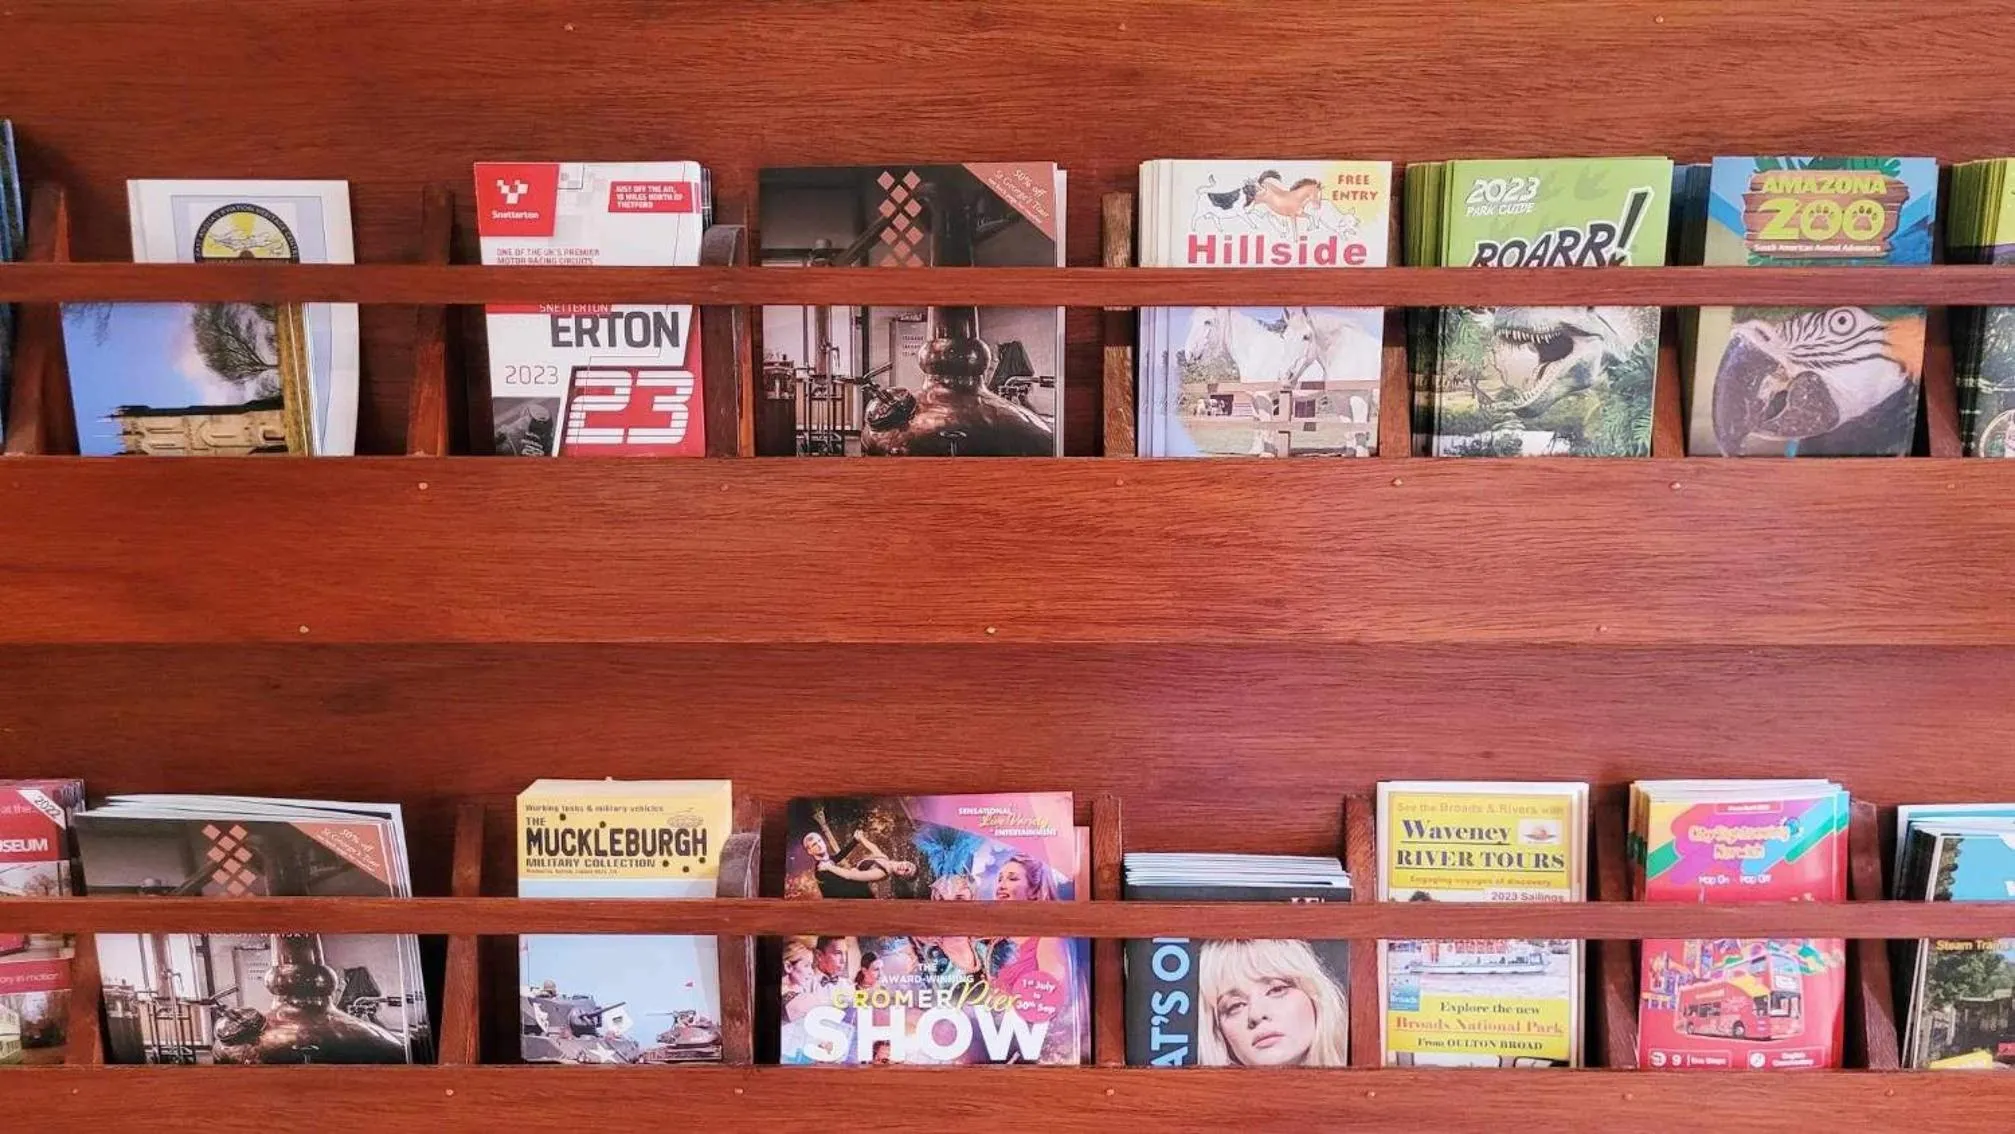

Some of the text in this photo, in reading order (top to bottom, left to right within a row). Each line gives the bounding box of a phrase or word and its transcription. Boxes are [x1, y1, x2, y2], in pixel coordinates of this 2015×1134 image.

[1014, 168, 1033, 188] 50%
[1337, 174, 1371, 185] FREE
[1762, 175, 1887, 194] AMAZONA
[1332, 190, 1378, 201] ENTRY
[1465, 176, 1541, 203] 2023
[491, 210, 540, 219] Snetterton
[1465, 202, 1536, 217] PARK GUIDE
[1471, 187, 1650, 267] ROARR!
[1758, 197, 1886, 241] ZOO
[1187, 234, 1368, 266] Hillside
[550, 311, 681, 348] ERTON
[505, 364, 559, 385] 2023
[565, 370, 694, 444] 23
[34, 795, 62, 817] 2022
[526, 804, 560, 813] Working
[561, 805, 584, 813] tanks
[630, 804, 665, 812] vehicles
[958, 807, 1012, 815] SENSATIONAL
[526, 816, 547, 826] THE
[1402, 819, 1512, 845] Waveney
[526, 827, 708, 858] MUCKLEBURGH
[526, 858, 656, 868] MILITARY COLLECTION
[1397, 849, 1565, 869] RIVER TOURS
[1491, 890, 1565, 903] 2023 Sailings
[1935, 940, 1973, 951] Steam
[918, 962, 938, 972] THE
[881, 974, 975, 984] AWARD-WINNING
[1022, 978, 1056, 993] 1st July
[832, 979, 1021, 1012] CROMER Pier
[1037, 1004, 1057, 1015] Sep
[1440, 1001, 1540, 1014] Explore the new
[803, 1004, 1050, 1062] SHOW
[1396, 1016, 1563, 1034] Broads National Park
[1418, 1038, 1543, 1050] From OULTON BROAD
